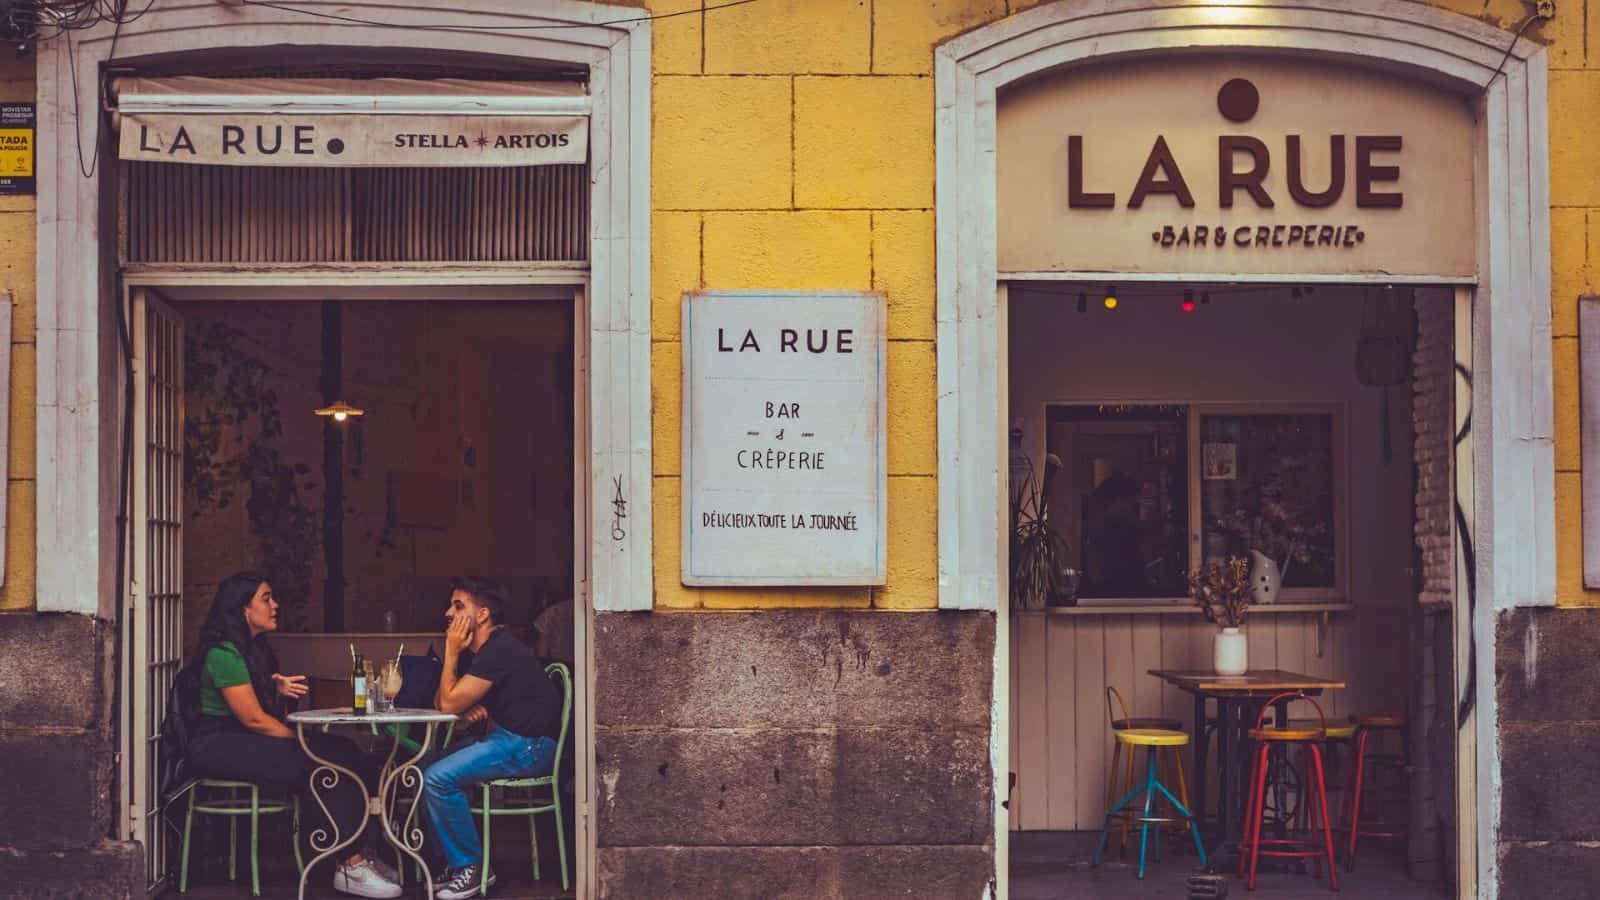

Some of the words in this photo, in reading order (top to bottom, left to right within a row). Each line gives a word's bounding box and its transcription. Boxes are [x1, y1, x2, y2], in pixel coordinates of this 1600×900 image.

[140, 125, 197, 154] LA
[222, 125, 315, 154] RUE
[394, 133, 469, 149] STELLA
[494, 133, 569, 149] ARTOIS
[1067, 134, 1195, 209] LA
[1217, 134, 1404, 209] RUE
[1160, 225, 1209, 248] BAR
[1213, 225, 1227, 248] &
[1232, 225, 1359, 248] CREPERIE
[717, 327, 761, 353] LA
[780, 328, 854, 354] RUE
[765, 400, 800, 419] BAR
[737, 448, 825, 471] CRÊPERIE
[757, 514, 787, 529] TOUTE
[791, 514, 806, 529] LA
[809, 511, 859, 532] JOURNÉE
